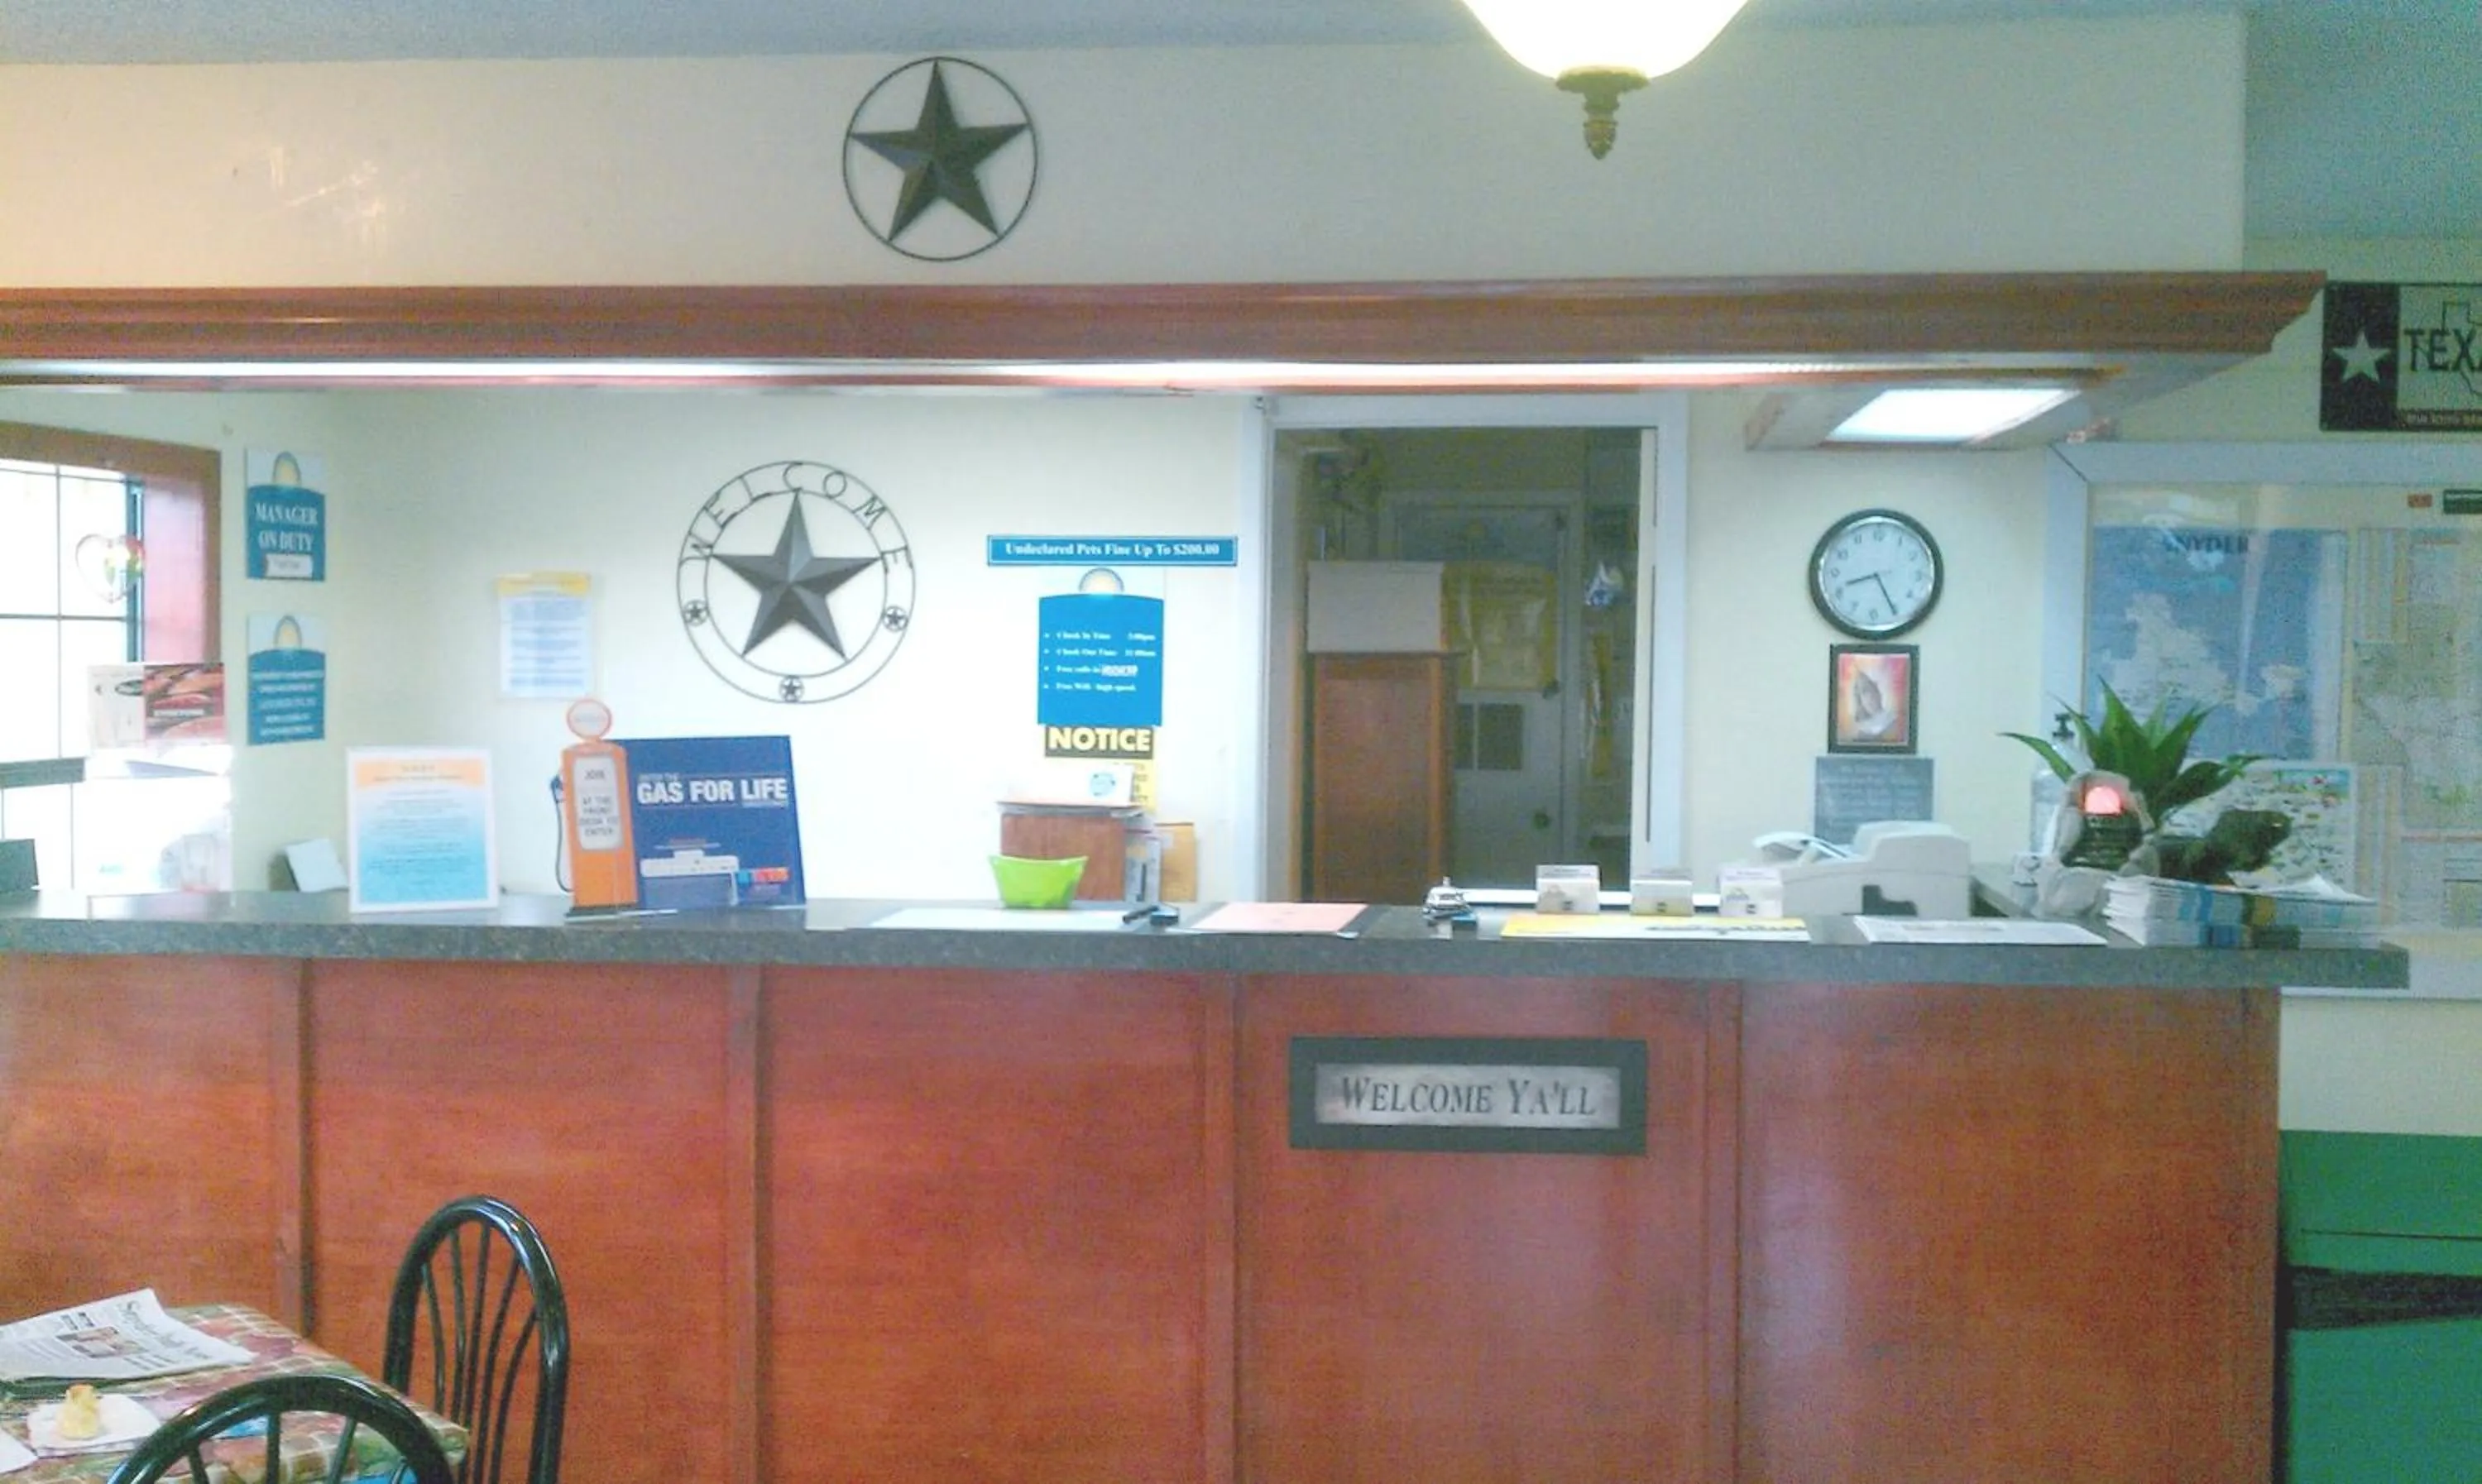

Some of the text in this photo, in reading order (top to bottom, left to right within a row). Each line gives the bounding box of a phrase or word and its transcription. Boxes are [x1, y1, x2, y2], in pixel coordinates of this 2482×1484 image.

[2403, 328, 2482, 372] TEX
[255, 502, 318, 525] MANAGER
[680, 462, 913, 574] WELCOME
[259, 529, 314, 551] ON DUTY
[1005, 543, 1219, 558] Undeclared Pets Fine Up To $200.00
[1047, 727, 1152, 752] NOTICE
[584, 769, 606, 781] JOIN
[637, 778, 788, 804] GAS FOR LIFE
[1341, 1076, 1598, 1116] WELCOME YA'LL
